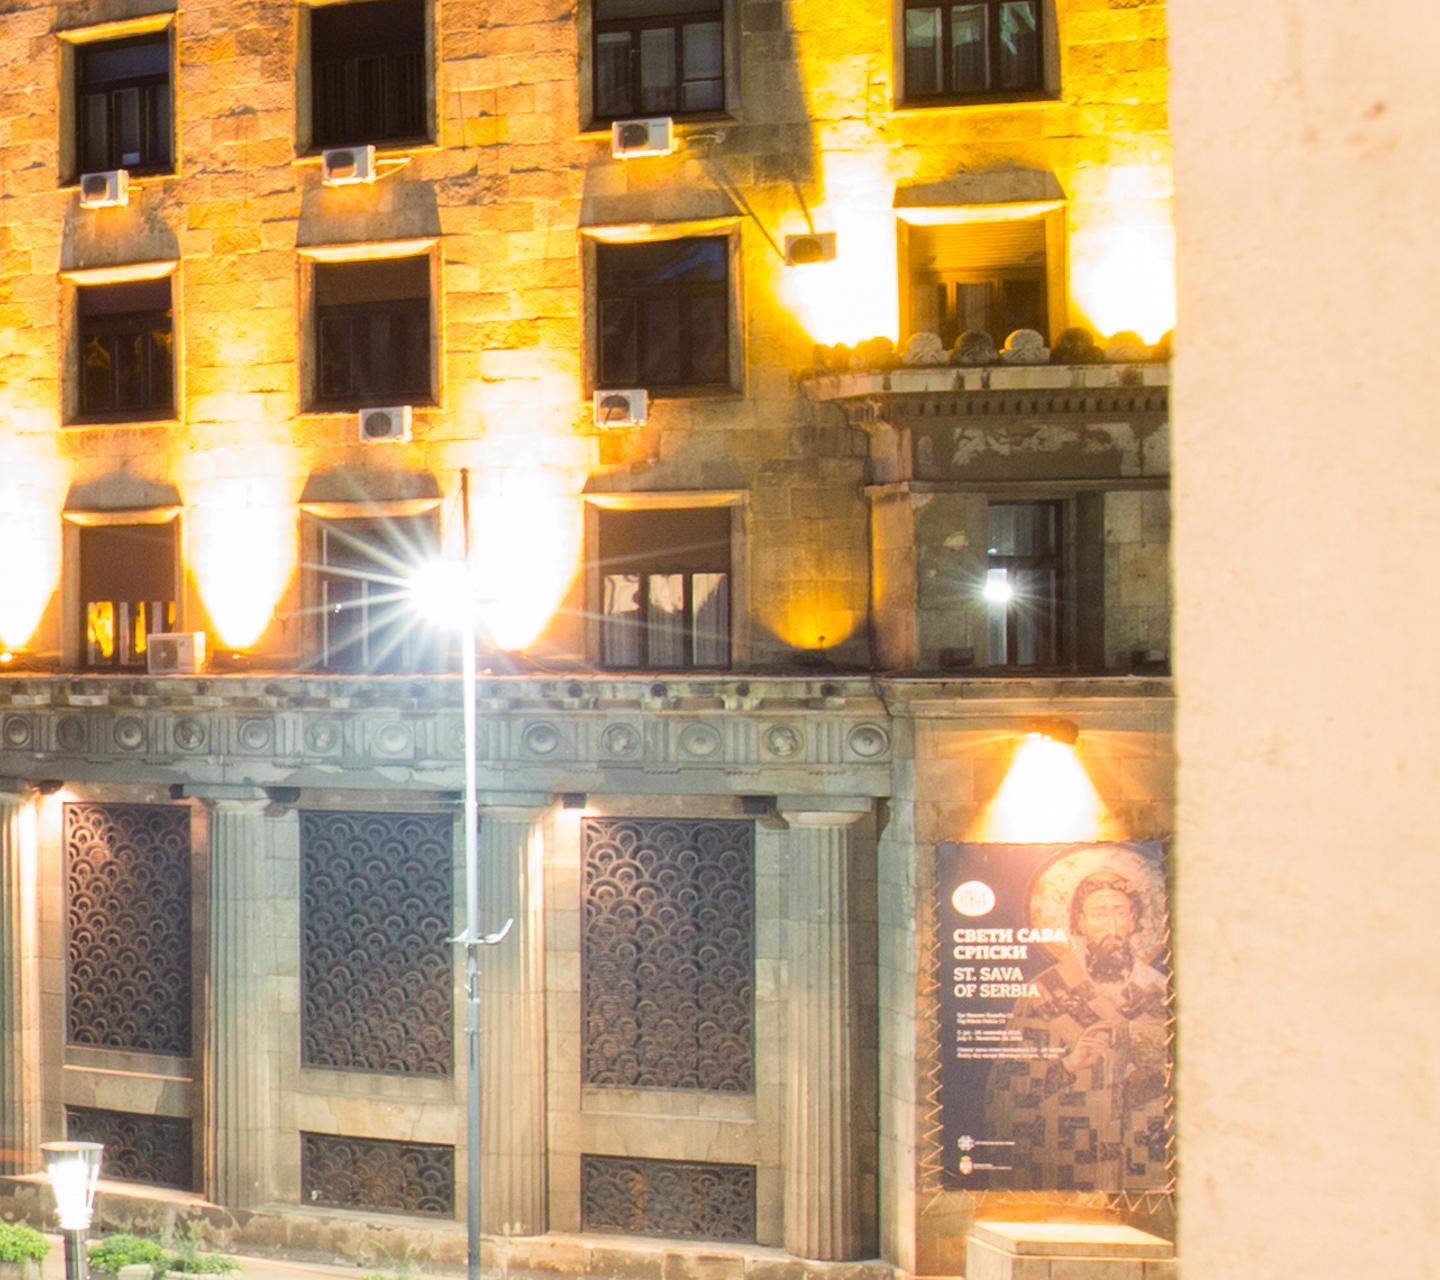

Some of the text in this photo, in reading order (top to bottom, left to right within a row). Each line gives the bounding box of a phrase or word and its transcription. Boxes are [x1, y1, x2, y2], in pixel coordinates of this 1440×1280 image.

[953, 927, 1067, 943] СВЕТИ САВА
[953, 945, 1028, 960] СРПСКИ
[953, 967, 1023, 982] ST. SAVA
[954, 983, 1041, 998] OF SERBIA
